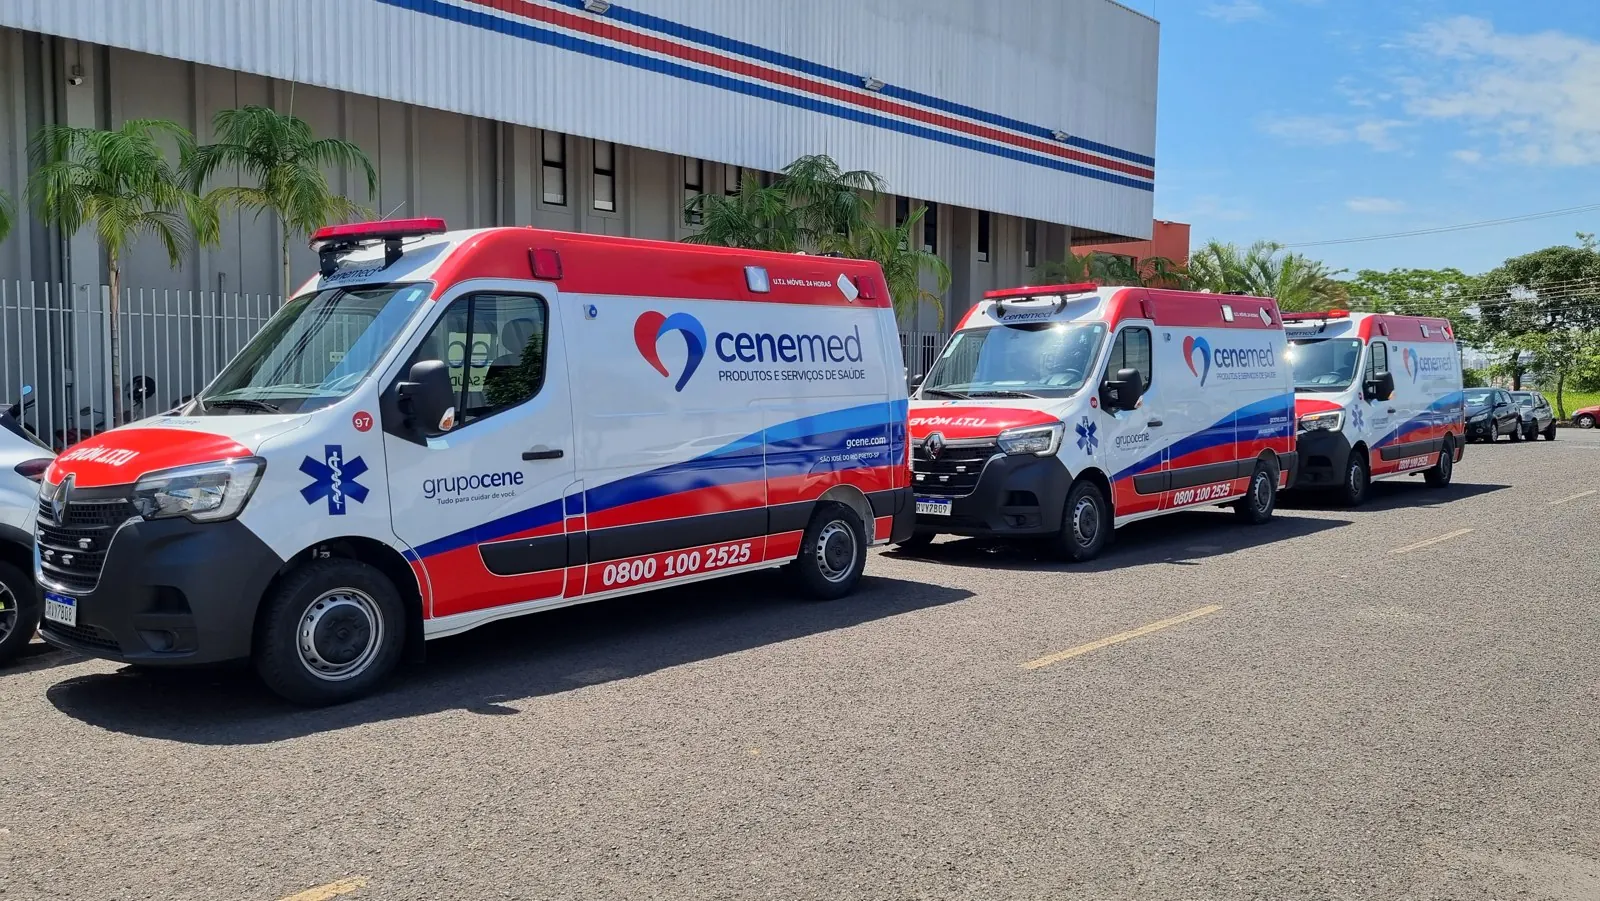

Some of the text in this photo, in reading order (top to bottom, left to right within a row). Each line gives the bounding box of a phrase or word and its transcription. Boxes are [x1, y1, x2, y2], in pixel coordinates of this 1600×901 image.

[786, 278, 806, 286] MÓVEL
[813, 280, 832, 288] HORAS
[1003, 311, 1052, 320] cenemed
[715, 324, 863, 363] cenemed
[1214, 342, 1275, 368] cenemed
[718, 367, 866, 383] PRODUTOS E SERVIÇOS DE SAÚDE
[355, 417, 370, 428] 97
[846, 436, 886, 449] gcene.com
[1115, 432, 1150, 448] grupocene
[819, 455, 831, 463] SÃO
[831, 453, 842, 462] JOSÉ
[850, 452, 858, 460] RIO
[422, 471, 524, 498] grupocene
[455, 496, 470, 505] para
[471, 493, 490, 502] cuidar
[491, 491, 500, 499] de
[1173, 483, 1231, 506] 0800 100 2525
[602, 543, 751, 586] 0800 100 2525
